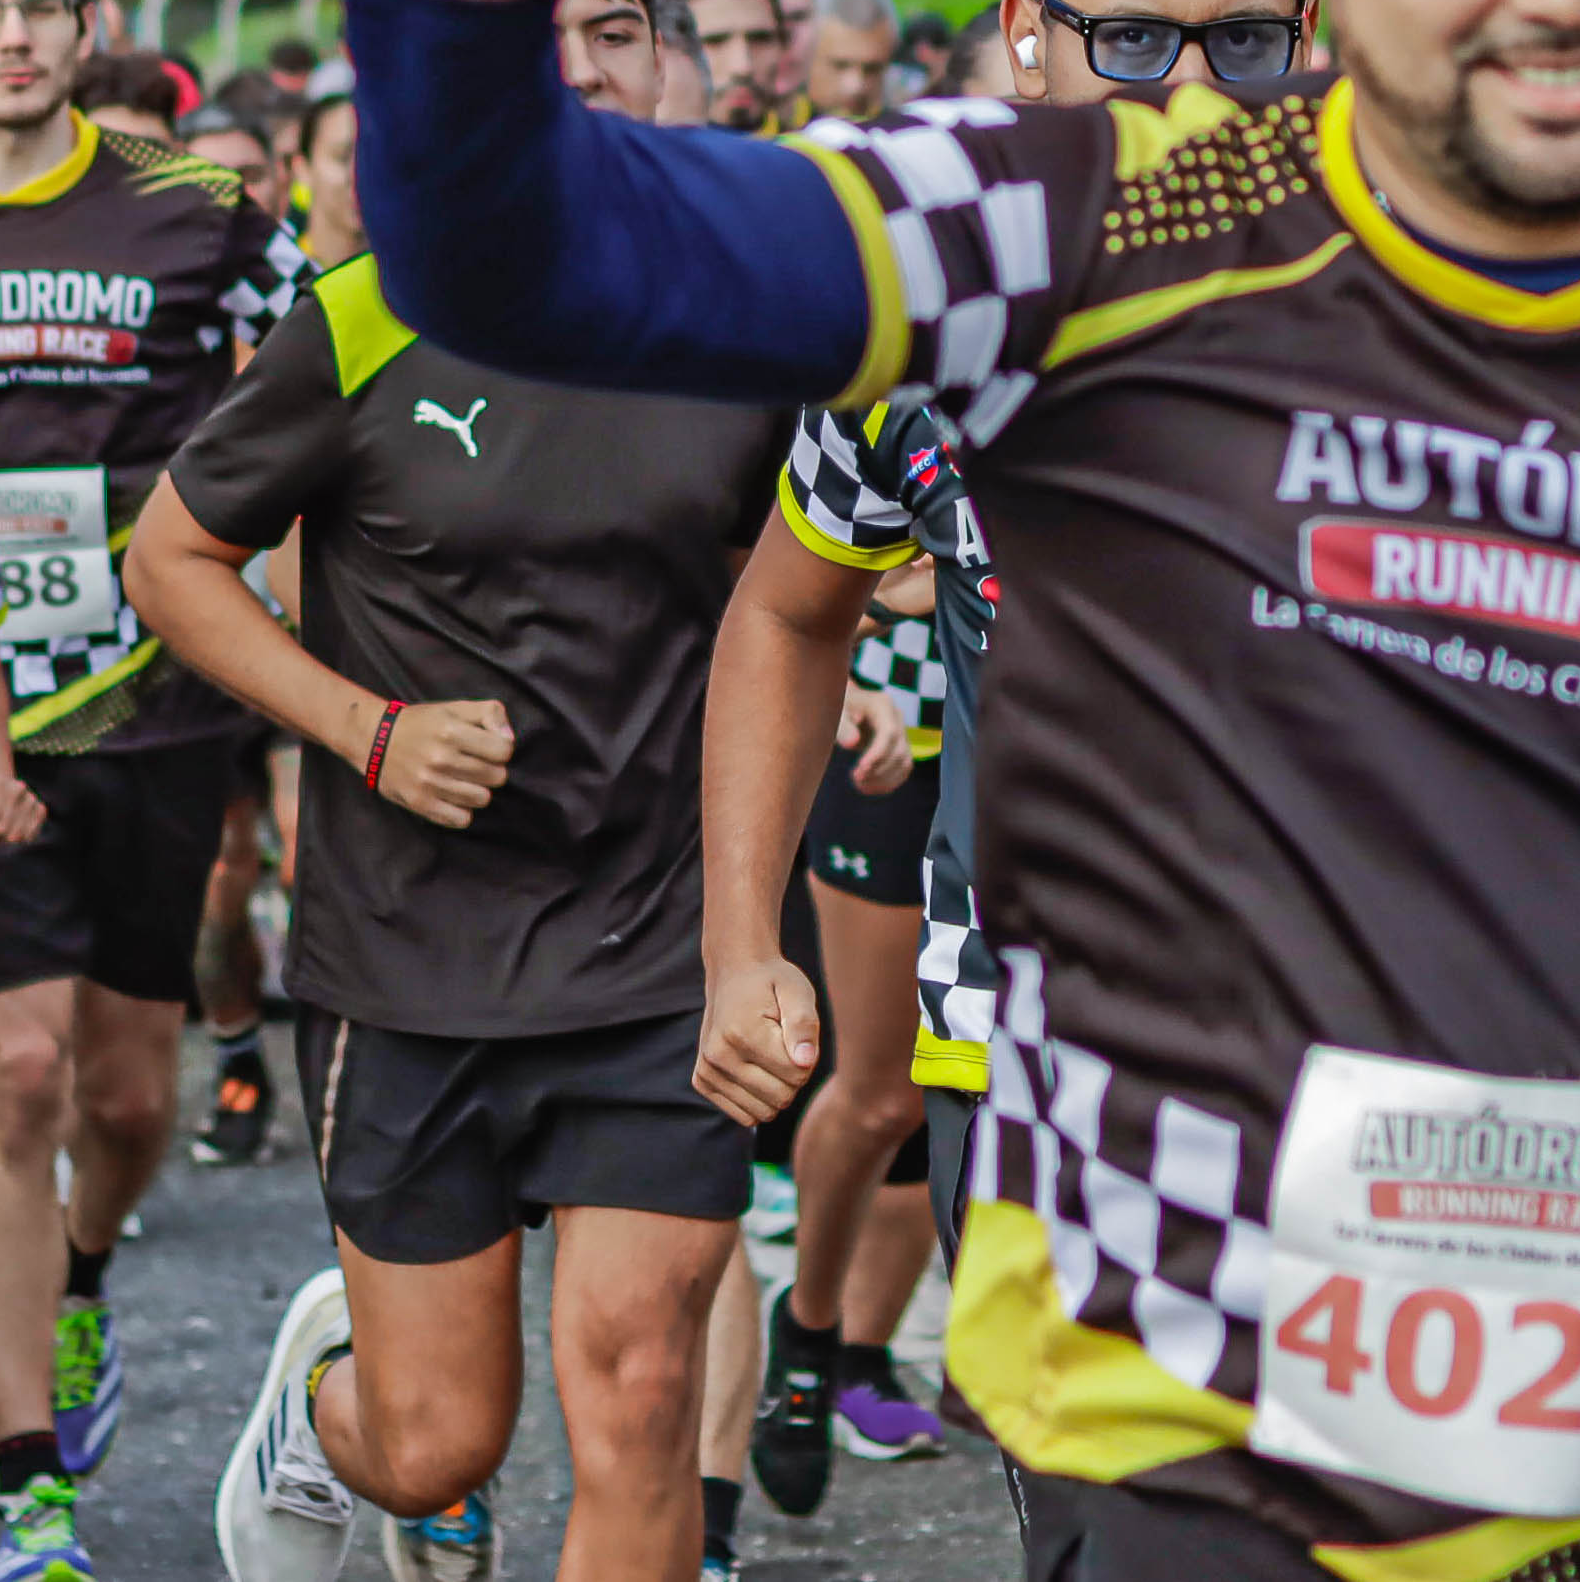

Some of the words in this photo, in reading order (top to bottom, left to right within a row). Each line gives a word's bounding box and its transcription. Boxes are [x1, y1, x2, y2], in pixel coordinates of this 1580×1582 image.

[43, 325, 110, 361] RACE
[1251, 585, 1301, 629] La
[1433, 635, 1486, 681] de
[1488, 645, 1548, 697] los
[1397, 1183, 1542, 1223] RUNNING
